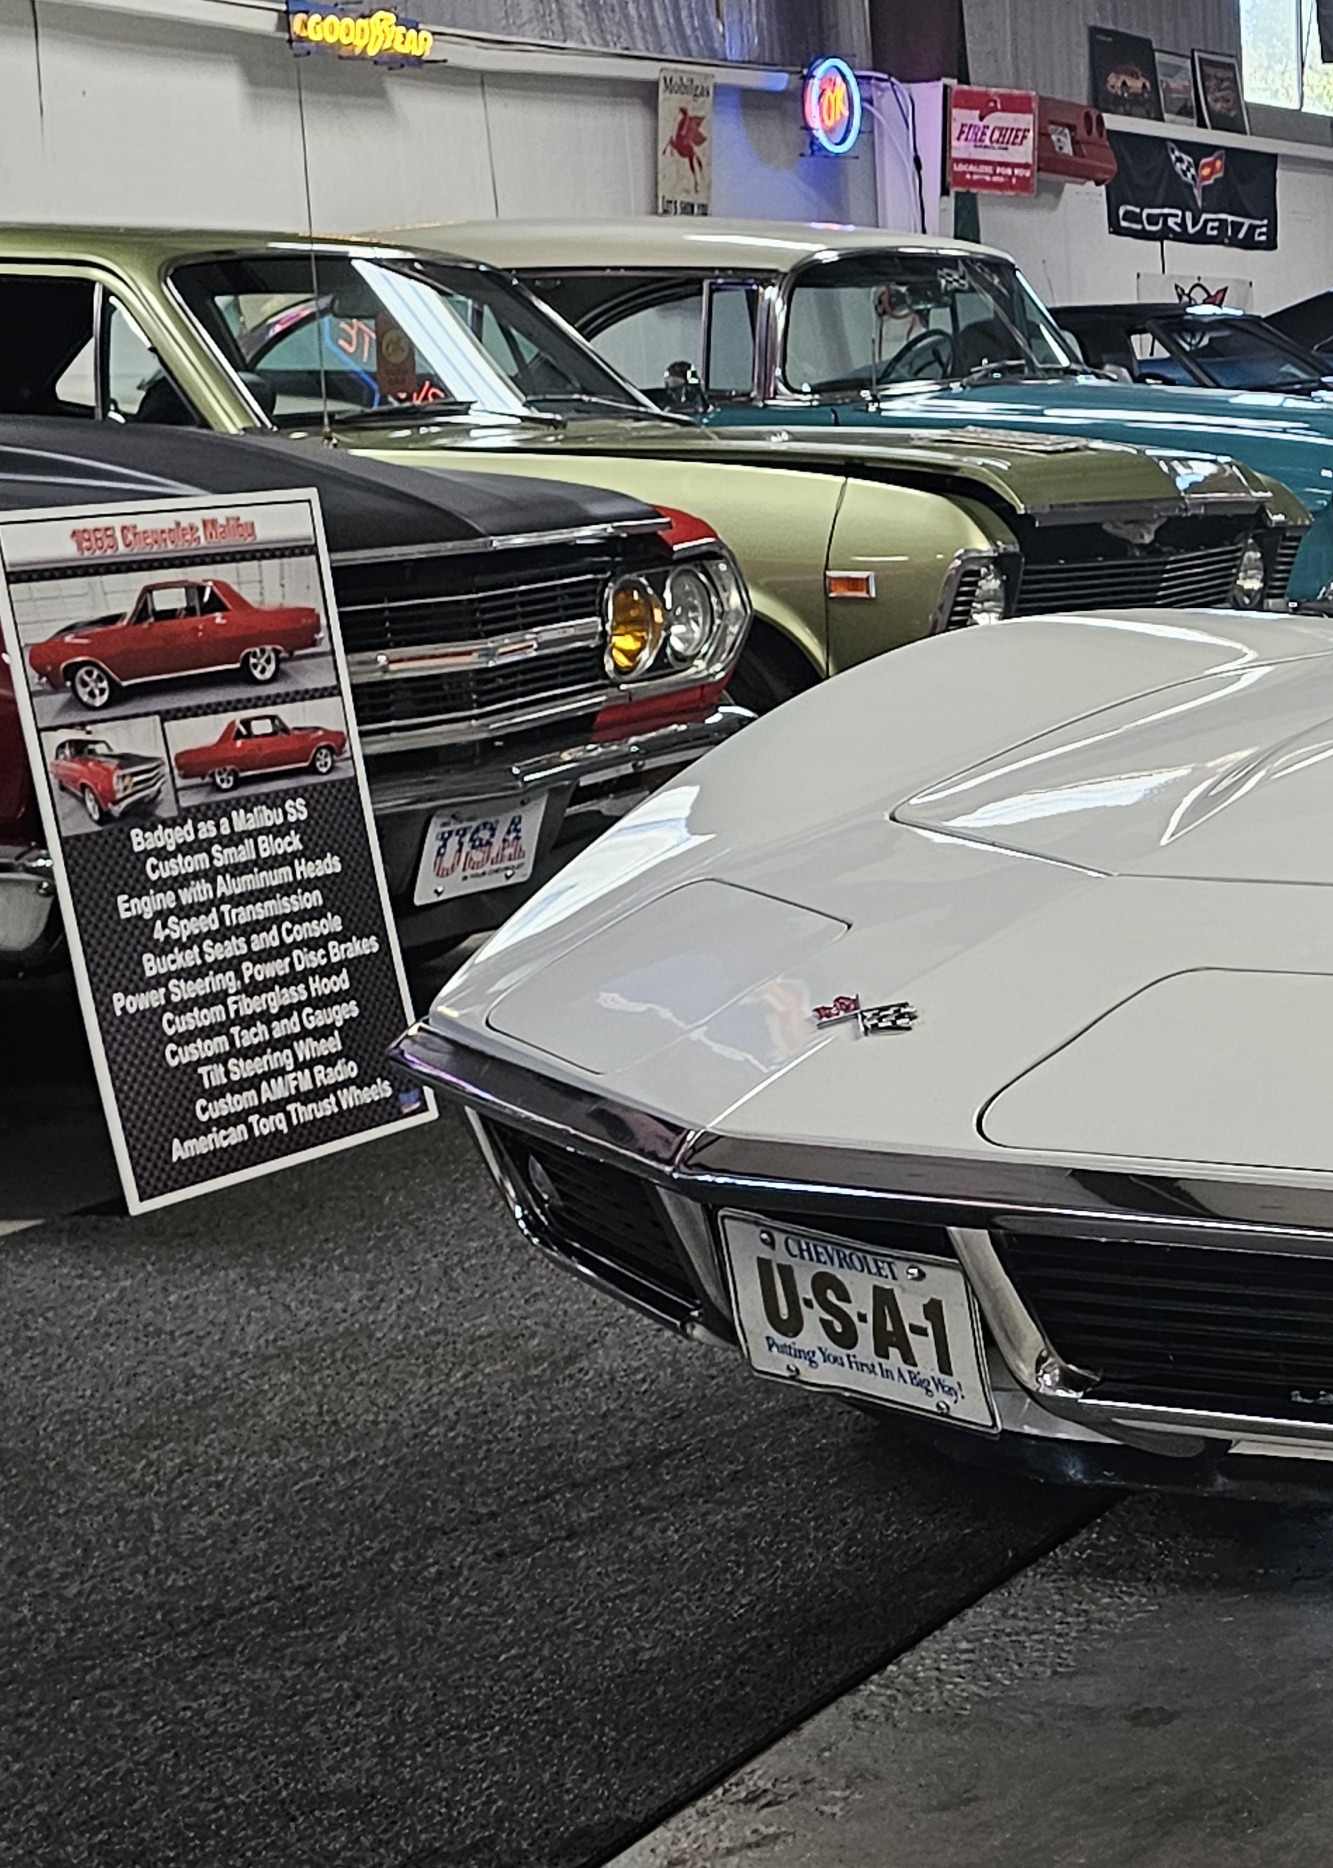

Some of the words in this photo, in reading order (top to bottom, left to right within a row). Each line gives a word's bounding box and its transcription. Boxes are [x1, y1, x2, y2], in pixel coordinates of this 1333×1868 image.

[300, 11, 433, 57] GOODYEAR
[663, 75, 710, 102] Mobilgas
[957, 123, 989, 144] FIRE
[989, 125, 1030, 147] CHIEF
[1119, 205, 1268, 241] CORVETTE
[70, 526, 119, 555] 1965
[120, 521, 200, 552] Chevrolet
[202, 516, 258, 543] Malibu
[130, 819, 195, 851] Badged
[198, 819, 217, 839] as
[220, 817, 231, 834] a
[231, 809, 284, 833] Malibu
[284, 797, 308, 823] SS
[433, 814, 525, 878] USA
[146, 851, 210, 880] Custom
[211, 838, 256, 867] Small
[257, 830, 303, 858] Block
[117, 890, 177, 919] Engine
[178, 879, 213, 905] with
[216, 865, 293, 898] Aluminum
[294, 853, 341, 880] Heads
[153, 907, 219, 942] 4-Speed
[220, 888, 323, 926] Transmission
[142, 945, 201, 977] Bucket
[202, 935, 247, 963] Seats
[250, 924, 280, 952] and
[281, 912, 343, 944] Console
[112, 986, 166, 1016] Power
[168, 968, 241, 1002] Steering,
[242, 956, 291, 985] Power
[293, 946, 327, 972] Disc
[329, 935, 379, 963] Brakes
[161, 1003, 226, 1036] Custom
[228, 979, 308, 1019] Fiberglass
[308, 967, 350, 998] Hood
[164, 1035, 229, 1068] Custom
[230, 1022, 269, 1050] Tach
[271, 1011, 300, 1038] and
[301, 999, 360, 1030] Gauges
[198, 1061, 225, 1090] Tilt
[227, 1048, 294, 1082] Steering
[293, 1030, 342, 1059] Wheel
[195, 1088, 259, 1122] Custom
[260, 1071, 314, 1104] AM/FM
[314, 1058, 358, 1087] Radio
[171, 1123, 248, 1163] American
[249, 1111, 288, 1138] Torq
[286, 1095, 338, 1127] Thrust
[337, 1078, 393, 1111] Wheels
[784, 1237, 899, 1281] CHEVROLET
[766, 1336, 816, 1369] Putting
[817, 1346, 845, 1367] You
[848, 1354, 876, 1374] First
[880, 1361, 895, 1381] In
[897, 1366, 909, 1385] A
[909, 1370, 933, 1398] Big
[931, 1375, 966, 1405] Way!
